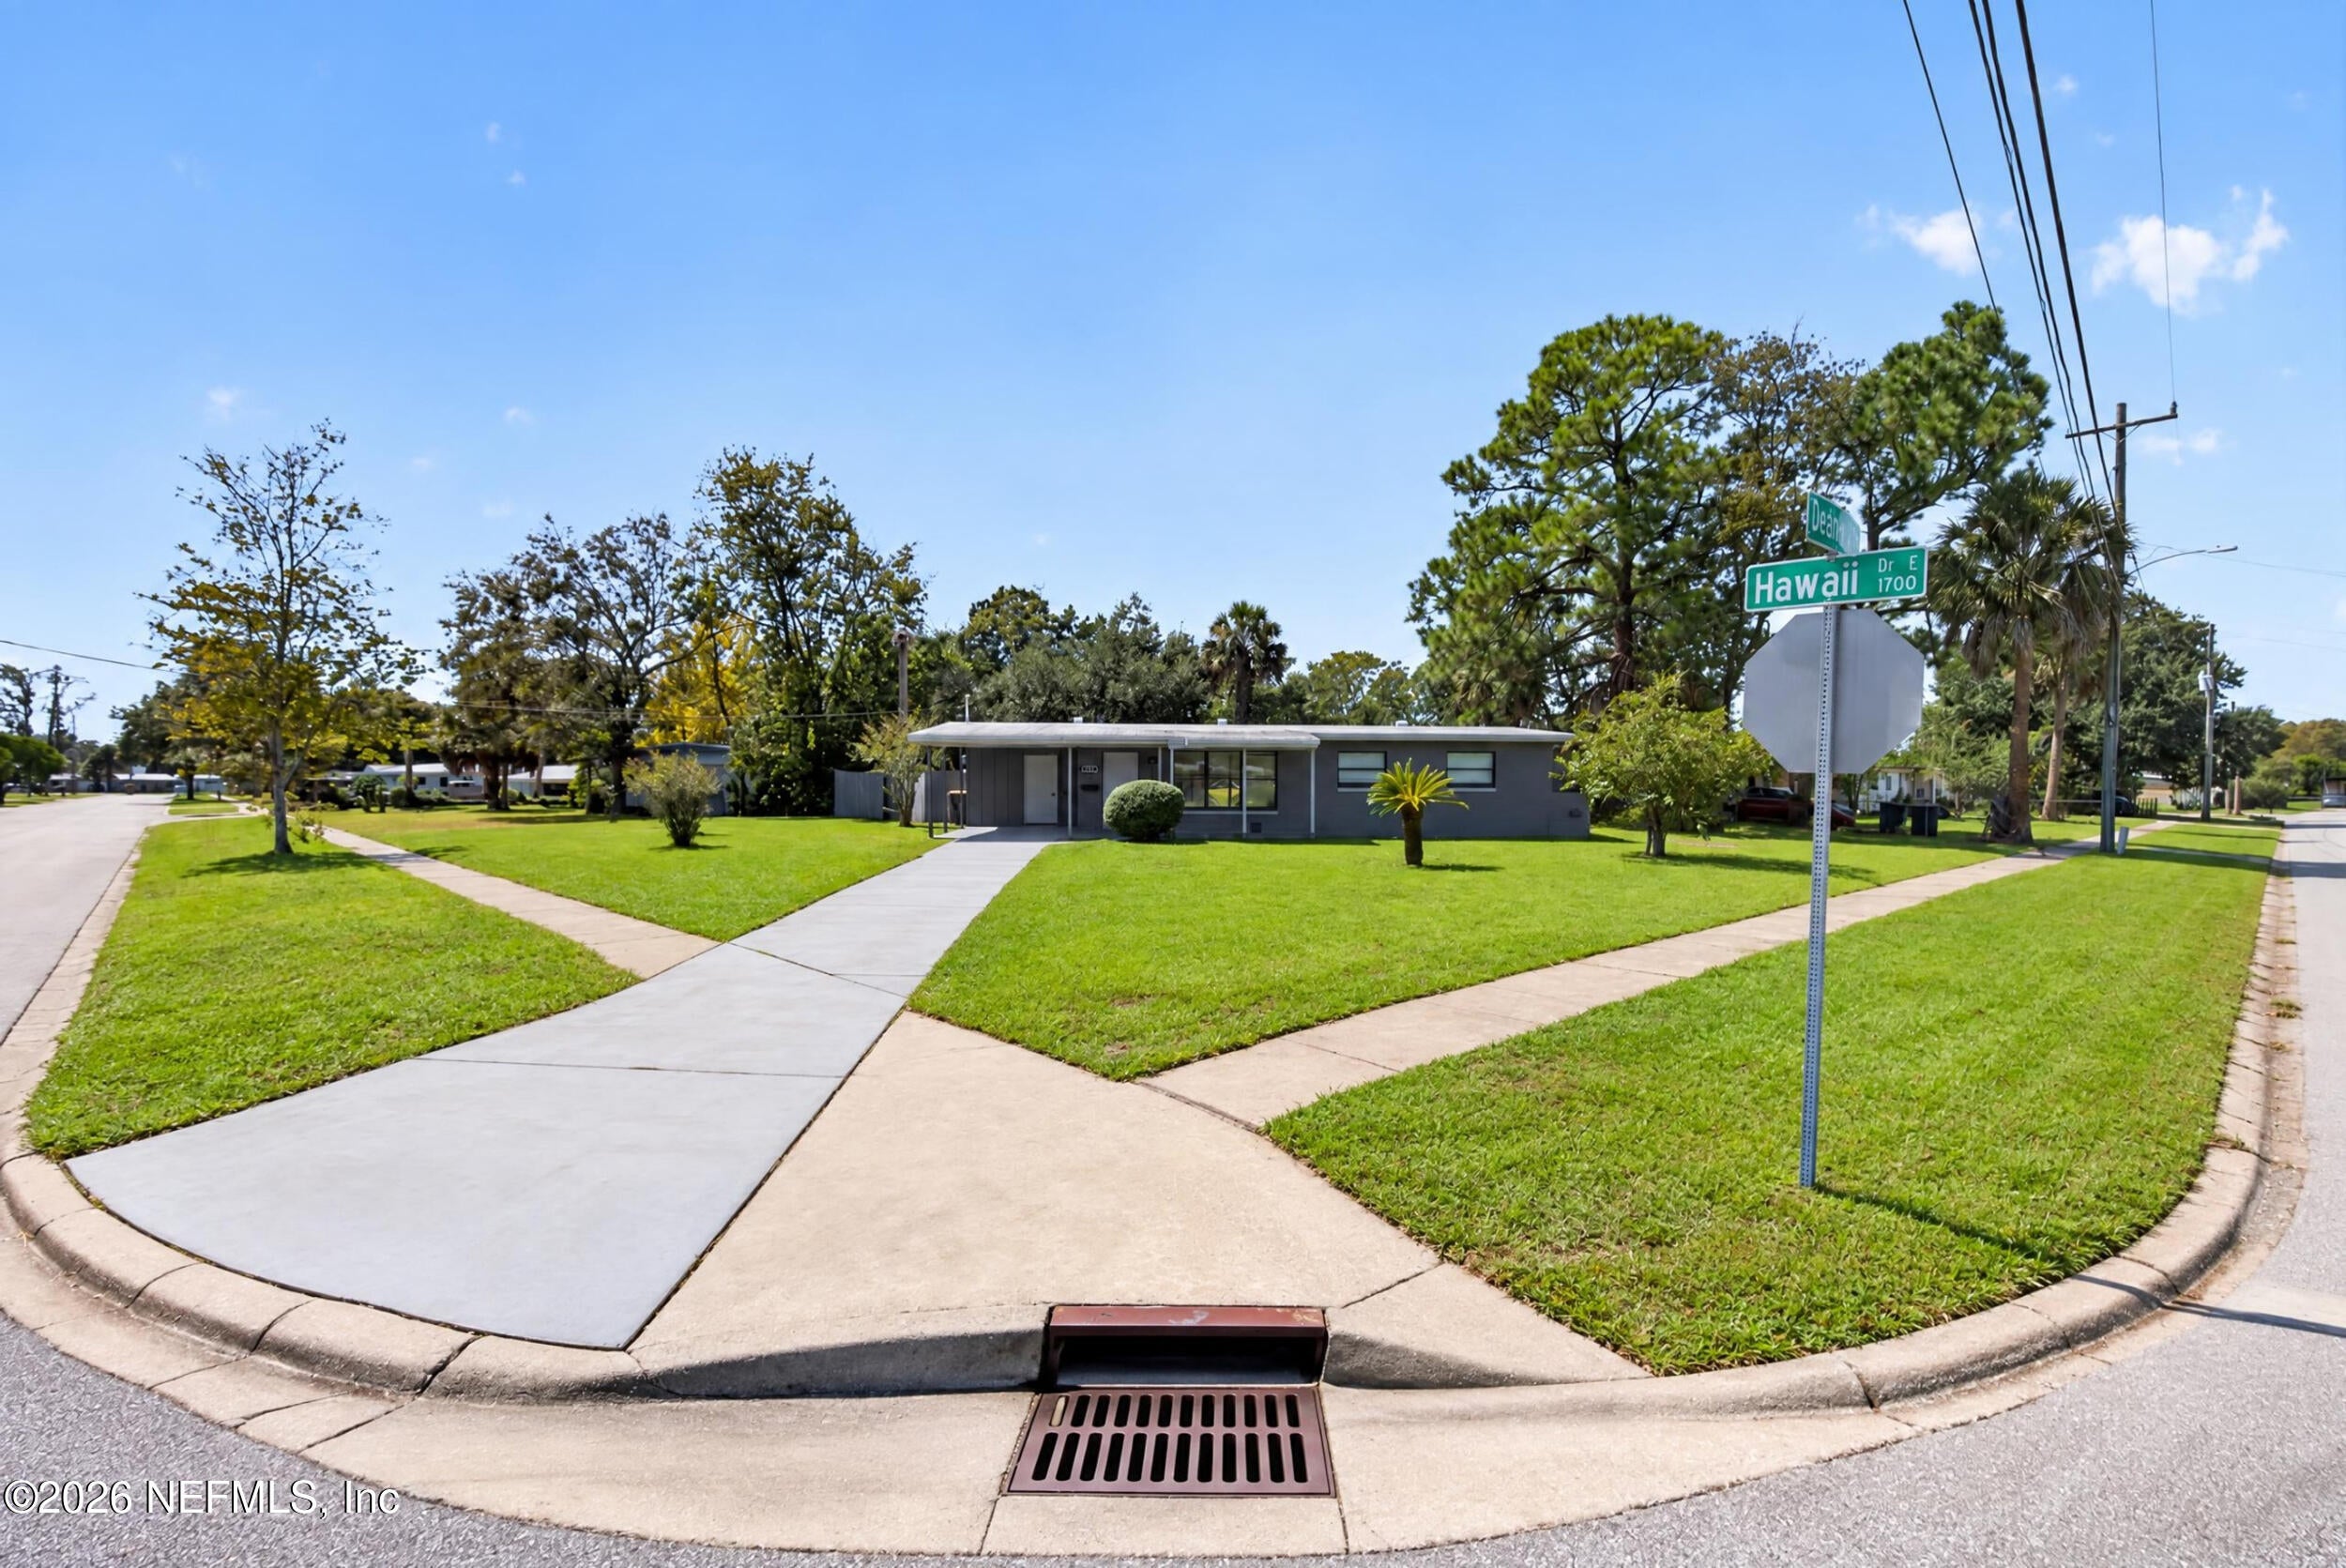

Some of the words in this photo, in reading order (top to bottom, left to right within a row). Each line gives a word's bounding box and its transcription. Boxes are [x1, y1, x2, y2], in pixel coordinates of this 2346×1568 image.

[1755, 560, 1858, 604] Hawaii
[1878, 557, 1894, 572] Dr
[1910, 555, 1918, 571] E
[1878, 575, 1917, 593] 1700
